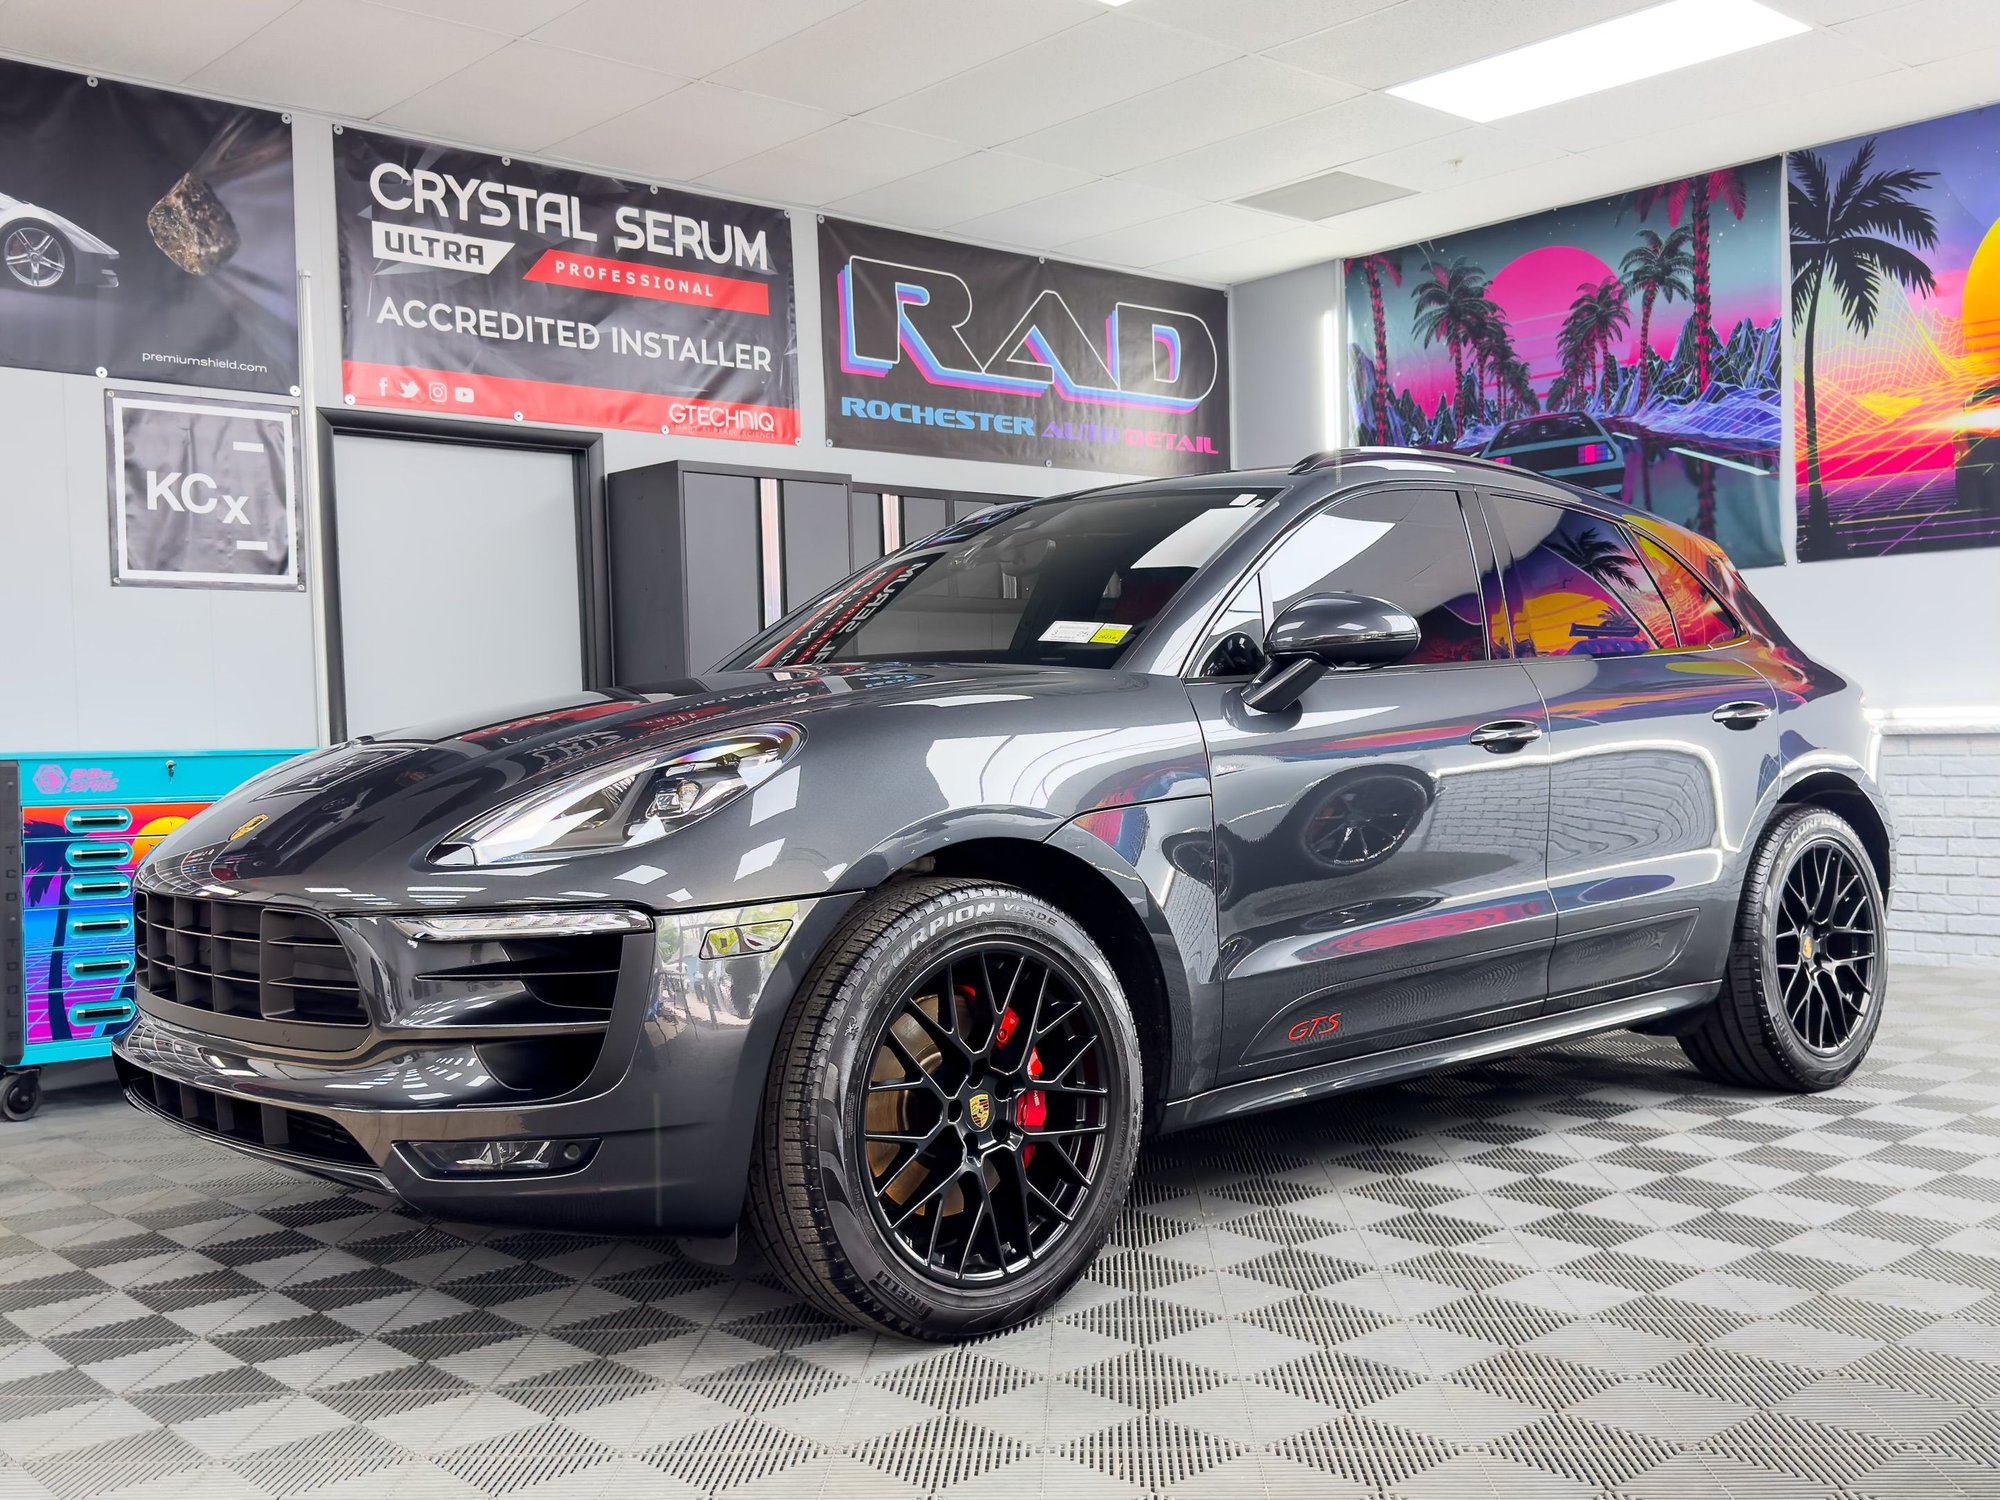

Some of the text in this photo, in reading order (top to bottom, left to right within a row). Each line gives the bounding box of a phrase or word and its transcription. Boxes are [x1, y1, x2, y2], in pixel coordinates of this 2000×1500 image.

[370, 162, 768, 271] CRYSTAL SERUM
[385, 230, 484, 266] ULTRA
[555, 260, 714, 297] PROFESSIONAL
[376, 296, 772, 373] ACCREDITED INSTALLER
[838, 255, 1218, 414] RAD
[142, 351, 268, 374] premiumshield.com
[669, 403, 775, 432] GTECHNIQ
[841, 396, 1219, 455] ROCHESTER AUTO DETAIL
[861, 902, 996, 1009] SCORPION
[1003, 902, 1059, 927] VERDE
[1288, 1013, 1342, 1041] GTS
